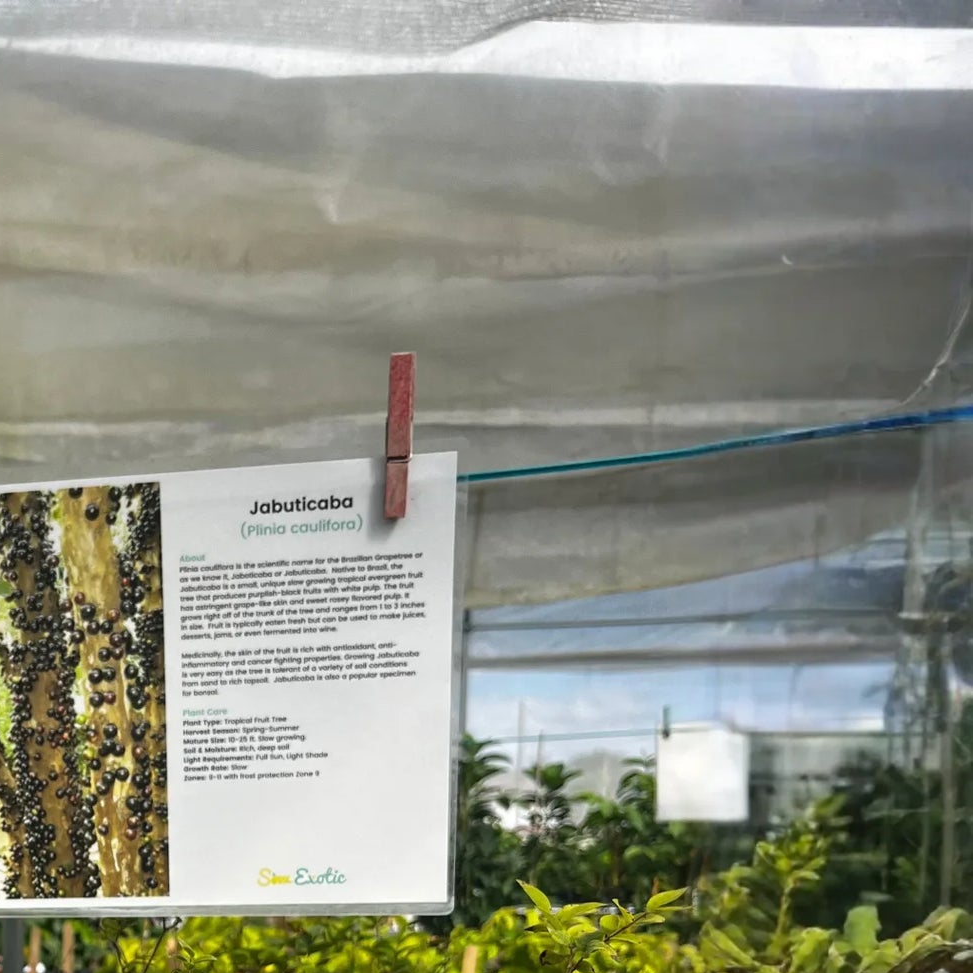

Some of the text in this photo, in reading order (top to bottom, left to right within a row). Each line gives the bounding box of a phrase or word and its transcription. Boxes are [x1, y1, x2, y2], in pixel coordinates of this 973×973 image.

[249, 495, 353, 515] Jabuticaba
[241, 514, 363, 540] (Plinia caulifora)
[179, 553, 205, 562] About
[179, 564, 198, 573] Plinia
[243, 561, 255, 569] the
[315, 557, 325, 565] for
[327, 556, 339, 564] the
[374, 552, 413, 563] Grapetree
[201, 573, 221, 582] know
[331, 565, 355, 574] Native
[390, 562, 403, 570] the
[180, 582, 221, 592] Jabuticaba
[259, 579, 285, 590] unique
[287, 578, 304, 586] slow
[305, 576, 336, 587] growing
[337, 574, 366, 585] tropical
[367, 574, 406, 583] evergreen
[407, 571, 423, 579] fruit
[179, 594, 194, 602] tree
[195, 593, 210, 601] that
[212, 591, 246, 602] produces
[303, 586, 321, 595] fruits
[323, 585, 339, 594] with
[340, 584, 361, 593] white
[383, 582, 397, 591] The
[398, 581, 414, 590] fruit
[179, 603, 193, 611] has
[195, 601, 232, 612] astringent
[273, 598, 287, 606] skin
[289, 597, 304, 605] and
[305, 596, 327, 604] sweet
[180, 600, 425, 623] grows right off the trunk the tree and ranges from inches
[207, 621, 223, 629] Fruit
[232, 618, 263, 630] typically
[264, 617, 286, 626] eaten
[287, 616, 305, 625] fresh
[307, 616, 320, 624] but
[349, 613, 368, 622] used
[379, 611, 401, 620] make
[263, 626, 301, 636] fermented
[302, 625, 317, 634] into
[224, 648, 236, 657] the
[237, 648, 252, 656] skin
[262, 646, 274, 655] the
[276, 646, 291, 654] fruit
[299, 645, 314, 653] rich
[316, 644, 331, 652] with
[231, 658, 245, 666] and
[273, 655, 302, 666] fighting
[343, 651, 375, 662] Growing
[377, 649, 419, 659] Jabuticaba
[189, 671, 204, 679] very
[205, 670, 223, 678] easy
[235, 667, 247, 675] the
[248, 666, 263, 674] tree
[272, 664, 301, 673] tolerant
[318, 662, 343, 673] variety
[354, 661, 367, 670] soil
[368, 659, 408, 669] conditions
[181, 679, 198, 687] from
[200, 678, 218, 686] sand
[229, 676, 242, 685] rich
[273, 673, 315, 683] Jabuticaba
[324, 672, 339, 680] also
[348, 670, 377, 681] popular
[379, 668, 416, 680] specimen
[181, 688, 191, 696] for
[182, 707, 227, 717] Plant Care
[182, 714, 287, 727] Plant Type: Tropical Fruit Tree
[182, 727, 210, 736] Harvest
[257, 733, 274, 742] Slow
[183, 746, 196, 754] Soil
[257, 743, 275, 753] deep
[277, 742, 290, 750] soil
[183, 755, 201, 765] Light
[286, 751, 303, 761] Light
[305, 750, 328, 758] Shade
[183, 764, 209, 772] Growth
[230, 762, 248, 770] Slow
[223, 772, 238, 780] with
[239, 771, 255, 779] frost
[257, 770, 293, 780] protection
[295, 769, 313, 777] Zone
[295, 867, 347, 885] Exotic
